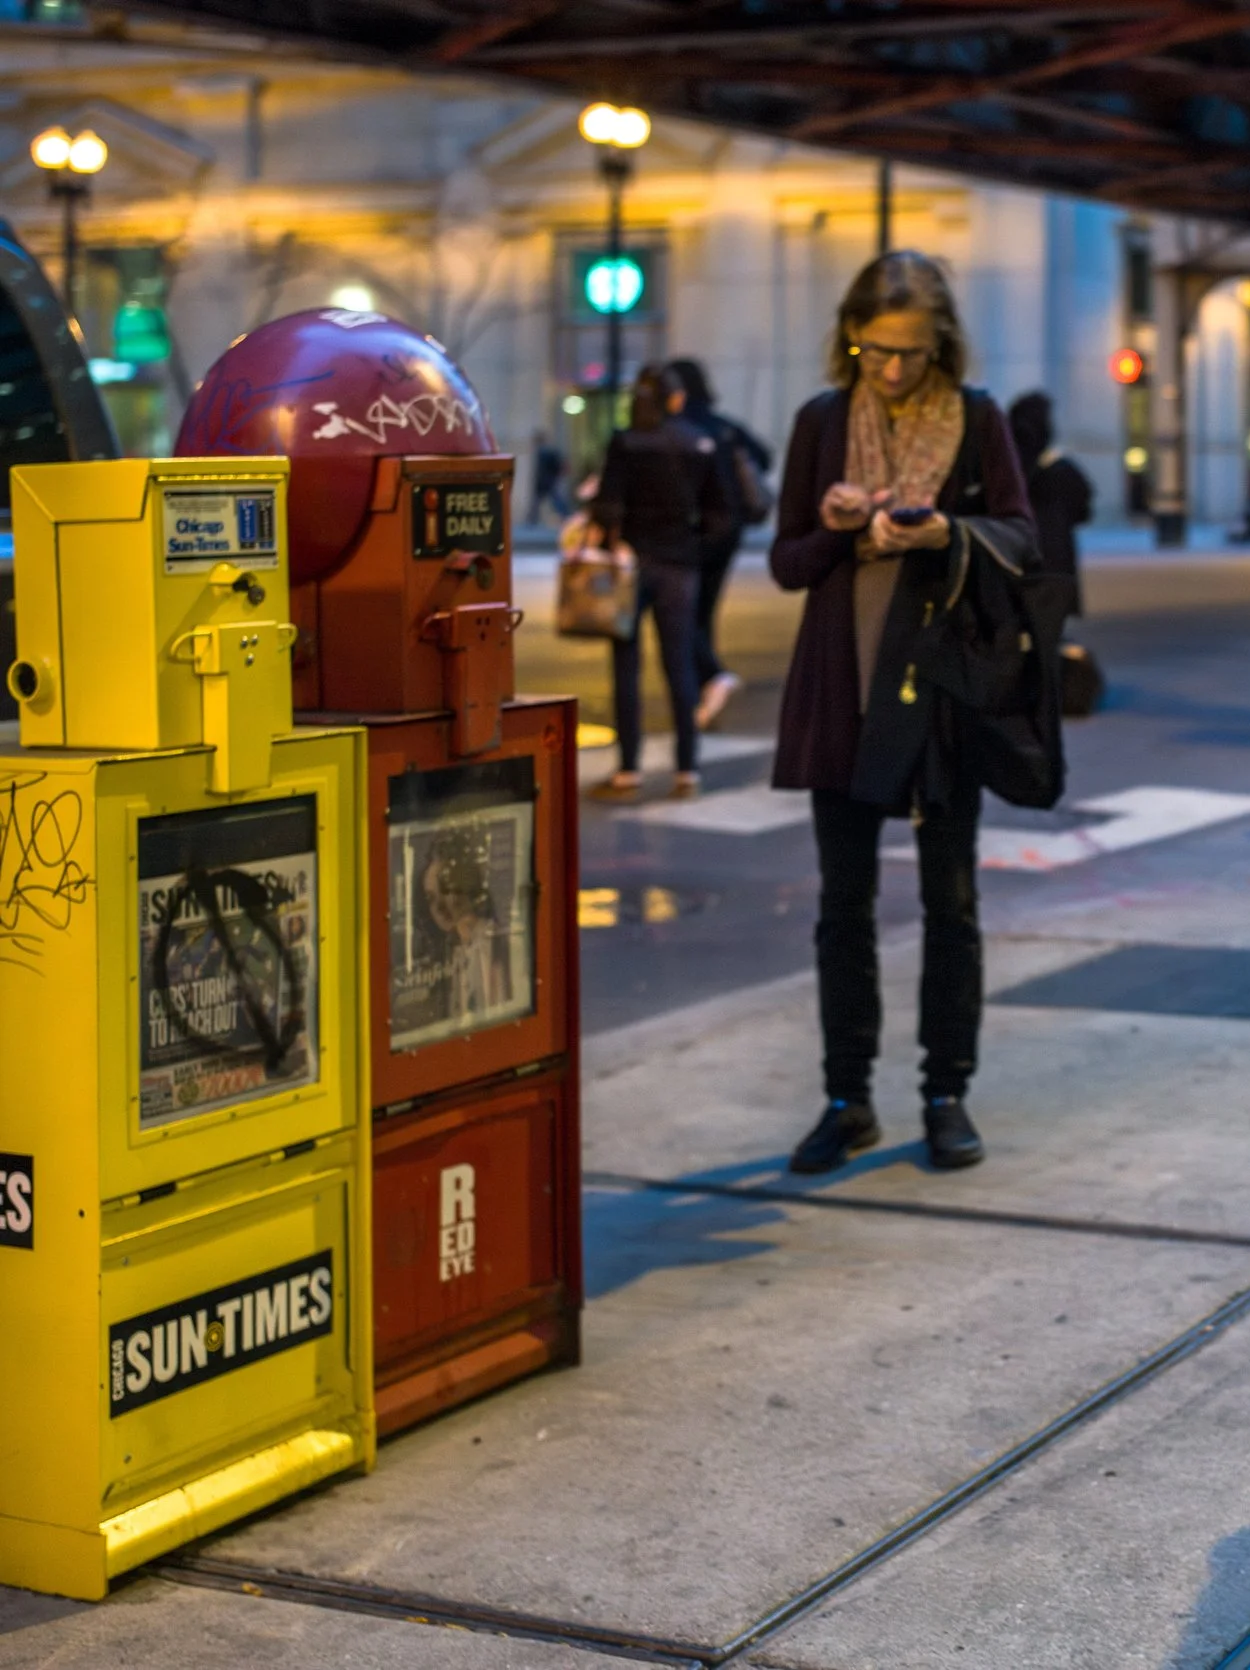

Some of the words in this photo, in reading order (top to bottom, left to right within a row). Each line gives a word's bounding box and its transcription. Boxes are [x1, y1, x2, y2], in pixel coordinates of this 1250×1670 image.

[446, 492, 489, 512] FREE
[176, 519, 224, 537] Chicago
[446, 516, 494, 537] DAILY
[191, 976, 226, 1009] TURN
[149, 1018, 168, 1048] TO
[213, 1001, 238, 1033] OUT
